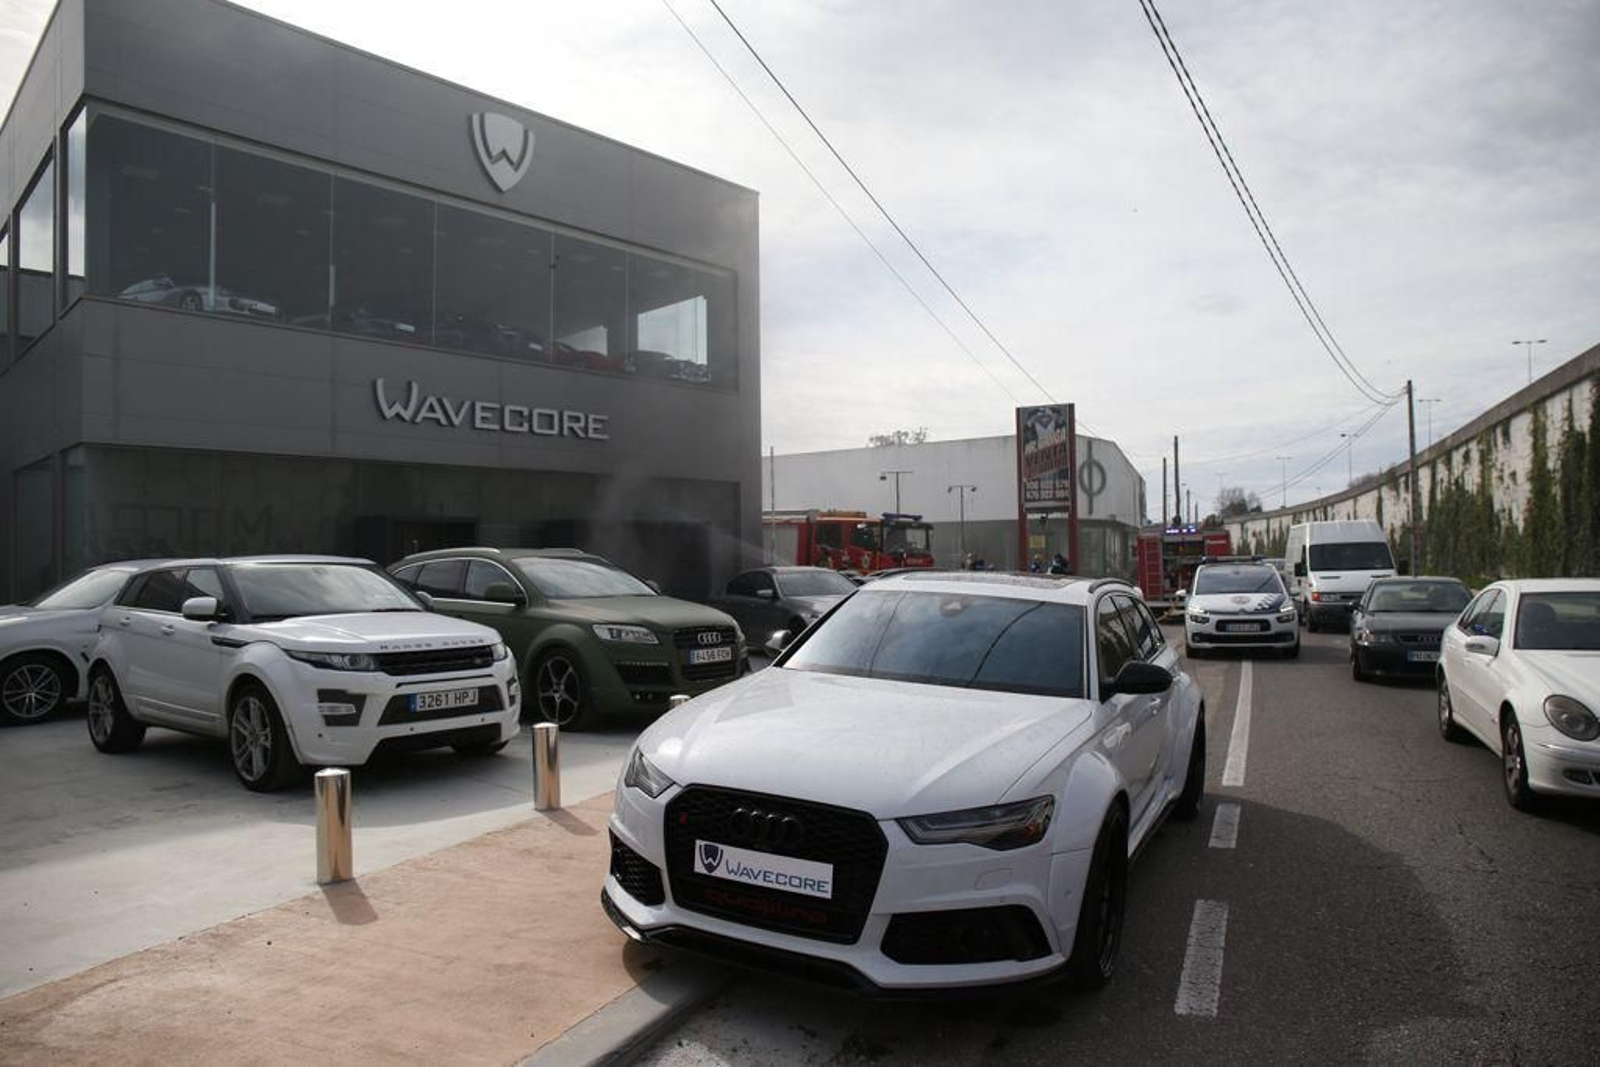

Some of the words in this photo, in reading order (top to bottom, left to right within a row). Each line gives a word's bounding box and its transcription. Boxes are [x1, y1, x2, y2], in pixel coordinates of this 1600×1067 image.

[375, 378, 609, 440] WAVECORE
[418, 693, 450, 708] 3261
[454, 690, 477, 705] HPJ
[726, 858, 829, 893] WAVECORE
